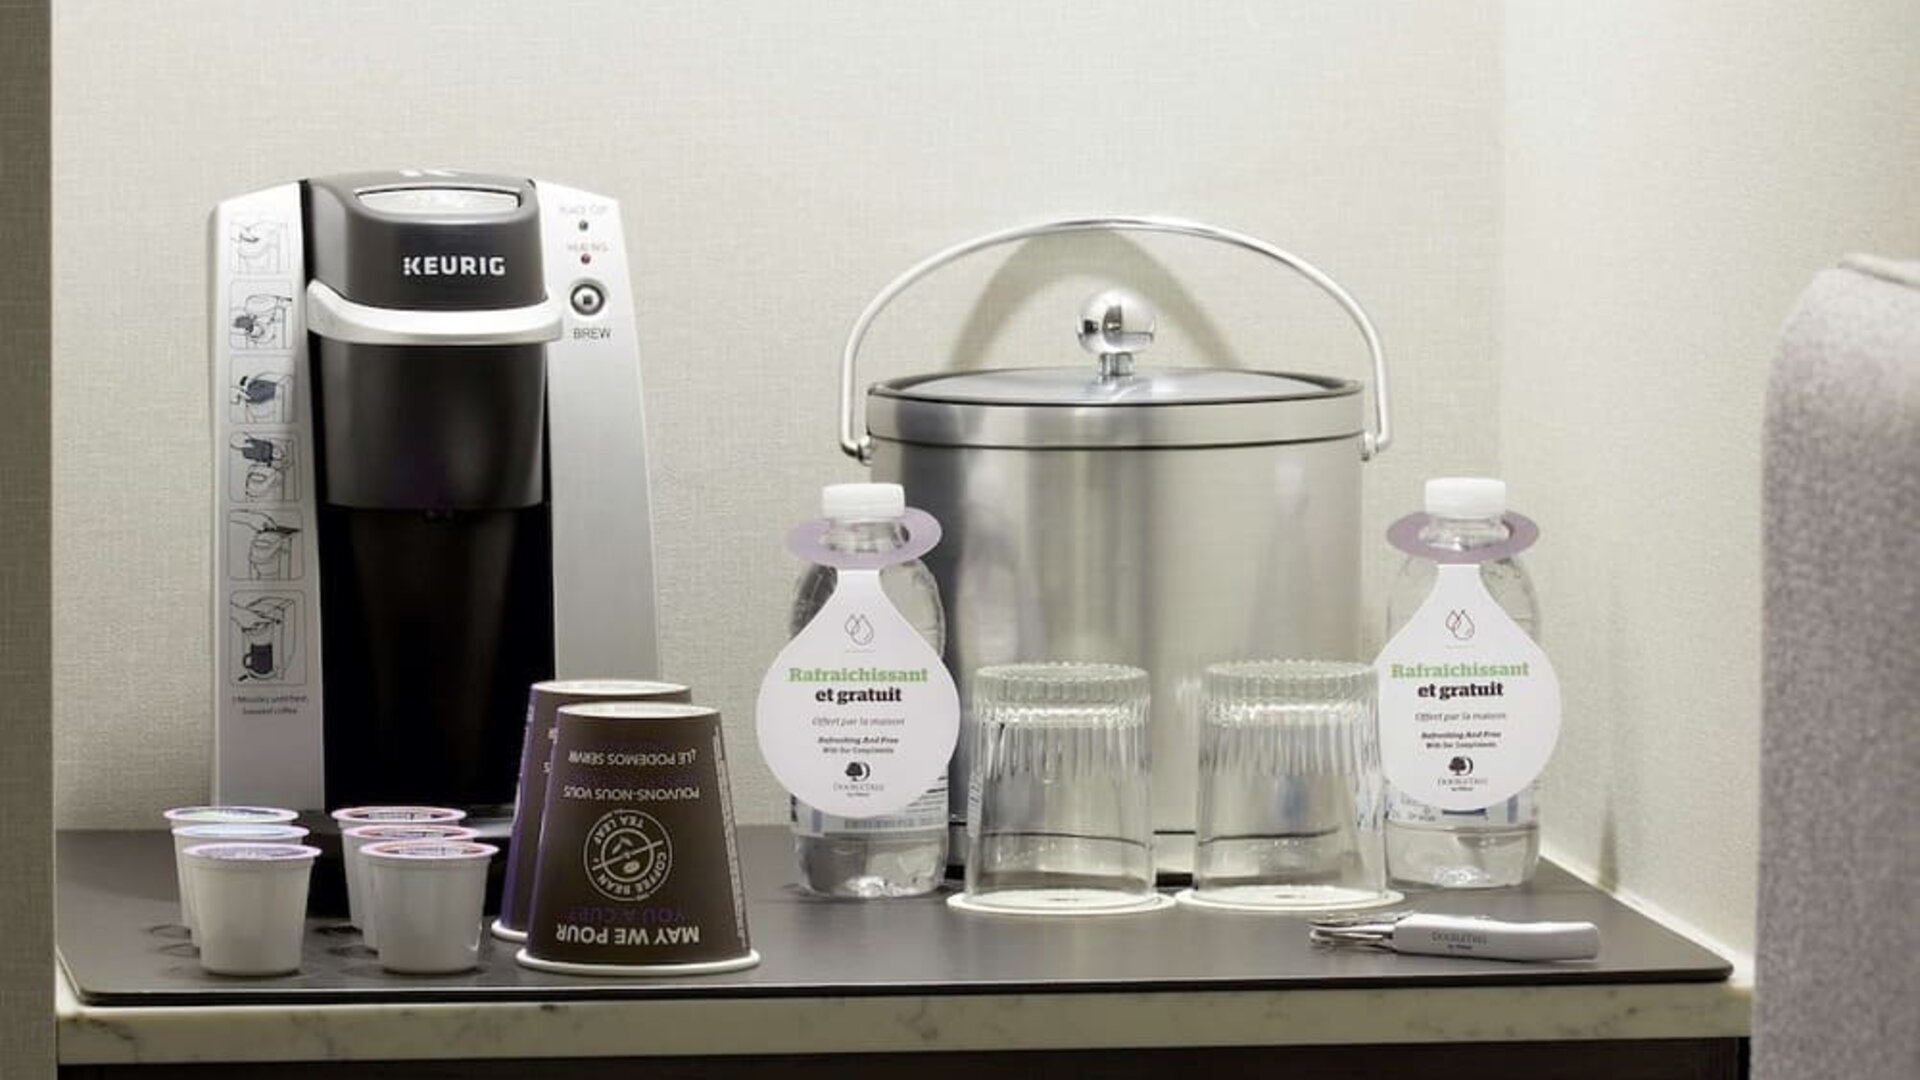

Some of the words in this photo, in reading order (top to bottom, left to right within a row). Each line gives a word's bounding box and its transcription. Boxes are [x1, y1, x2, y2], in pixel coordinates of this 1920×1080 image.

[403, 256, 505, 275] KEURIG
[573, 327, 612, 340] BREW
[815, 688, 833, 702] et
[837, 686, 902, 705] gratuit
[1418, 684, 1436, 697] et
[1439, 682, 1504, 700] gratuit
[607, 753, 676, 765] PODEMOS
[563, 785, 593, 798] VOUS
[595, 787, 700, 800] POUVONS-NOUS
[619, 815, 644, 828] TEA
[594, 819, 617, 844] LEAF
[635, 852, 667, 892] COFFEE
[597, 873, 631, 895] BEAN
[555, 924, 609, 944] POUR
[614, 927, 649, 945] WE
[654, 925, 700, 945] MAY
